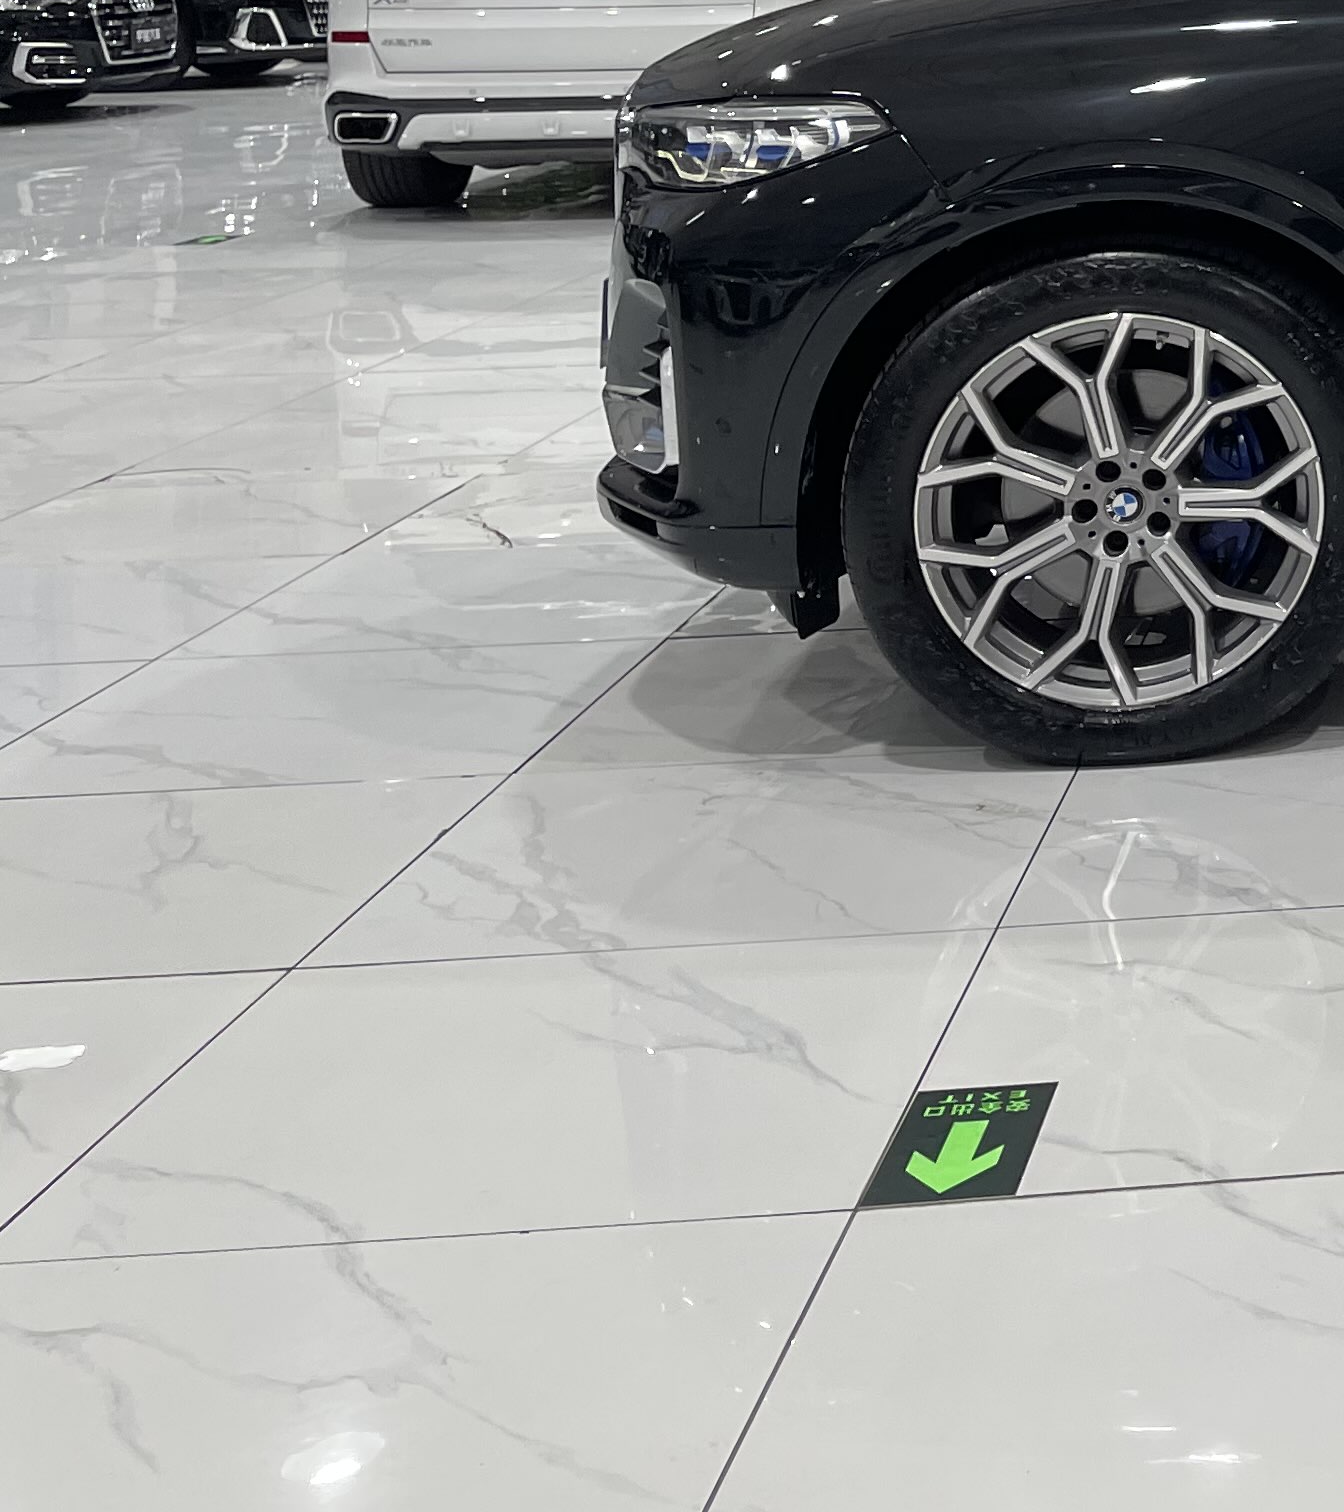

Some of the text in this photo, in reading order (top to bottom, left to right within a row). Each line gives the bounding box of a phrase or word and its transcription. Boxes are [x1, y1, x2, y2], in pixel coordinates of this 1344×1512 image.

[939, 1090, 1027, 1103] EXIT
[923, 1099, 1030, 1117] 安全出口
